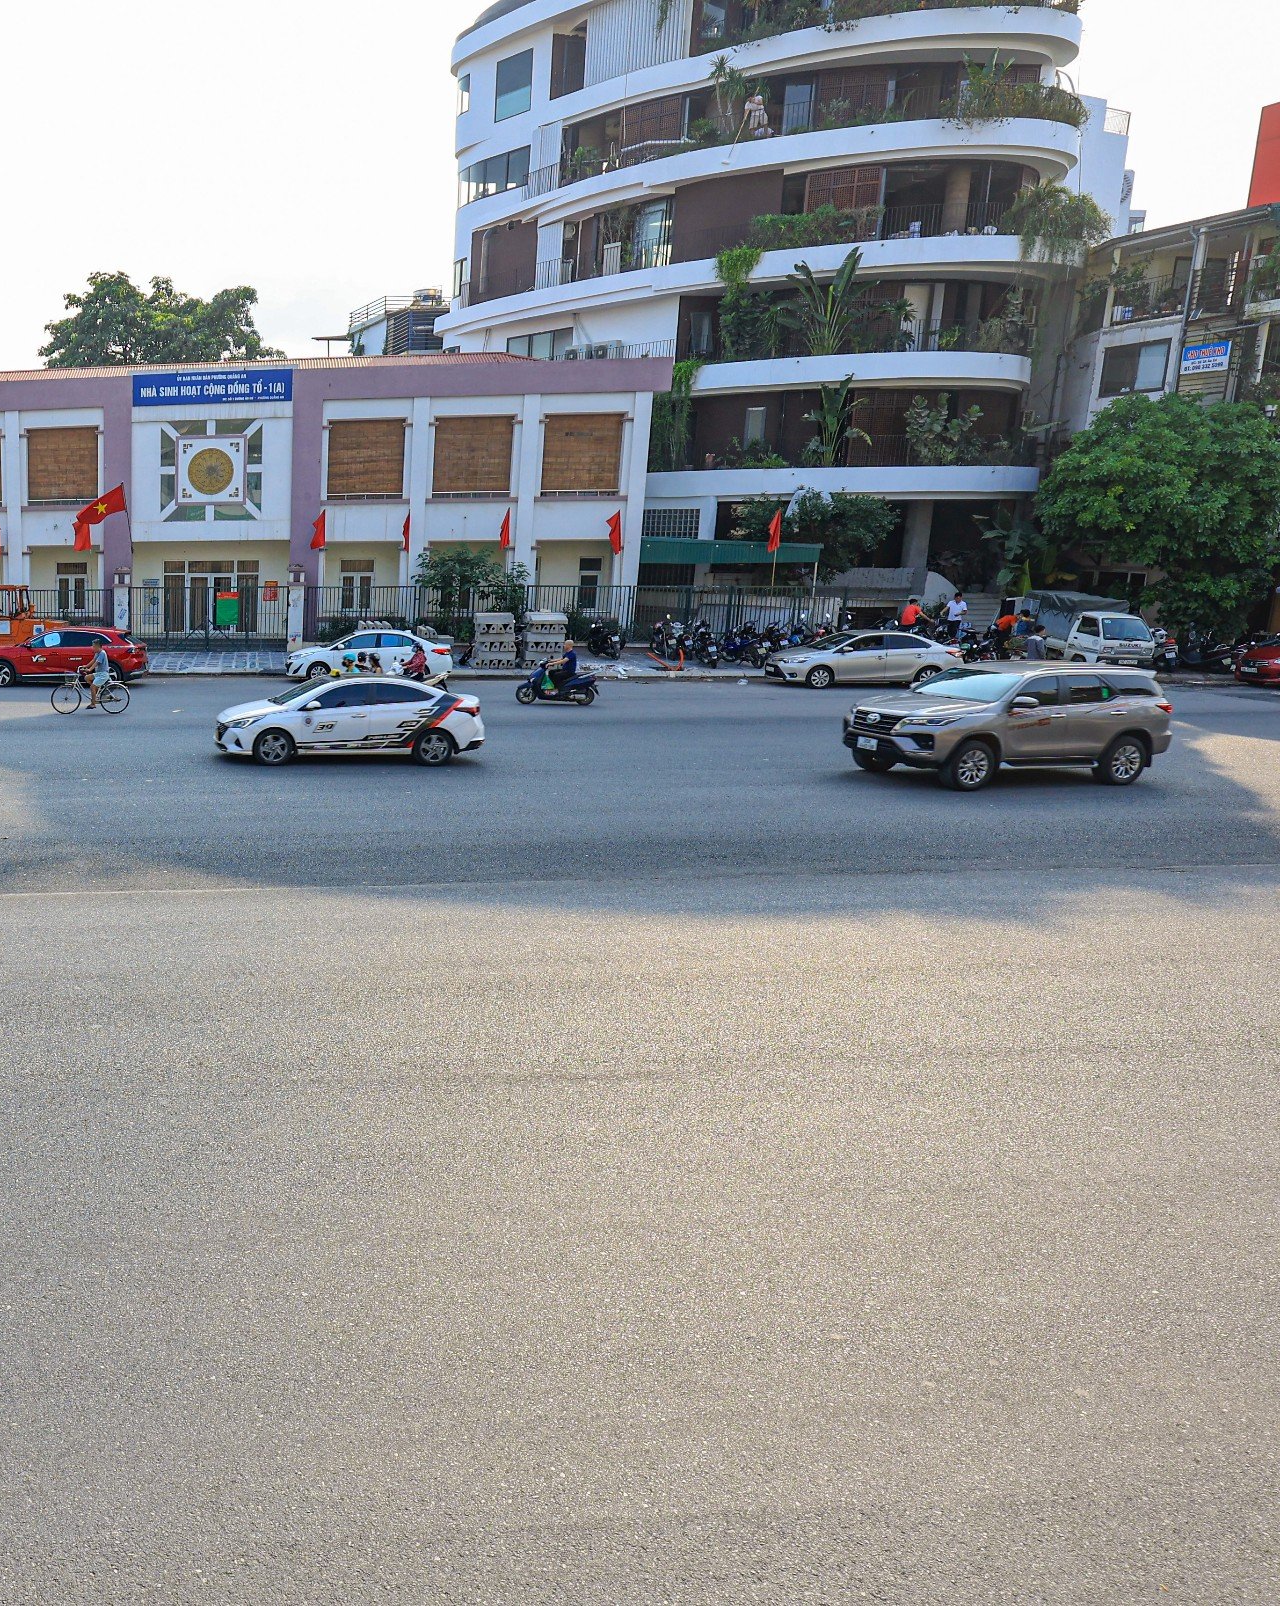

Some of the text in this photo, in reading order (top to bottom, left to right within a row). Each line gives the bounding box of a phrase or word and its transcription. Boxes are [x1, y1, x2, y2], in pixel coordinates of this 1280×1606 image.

[140, 384, 157, 398] NHÀ
[159, 386, 179, 397] SINH
[180, 385, 201, 398] HOẠT
[203, 382, 226, 398] CỘNG
[227, 380, 250, 395] ĐỒNG
[252, 378, 263, 394] TỔ
